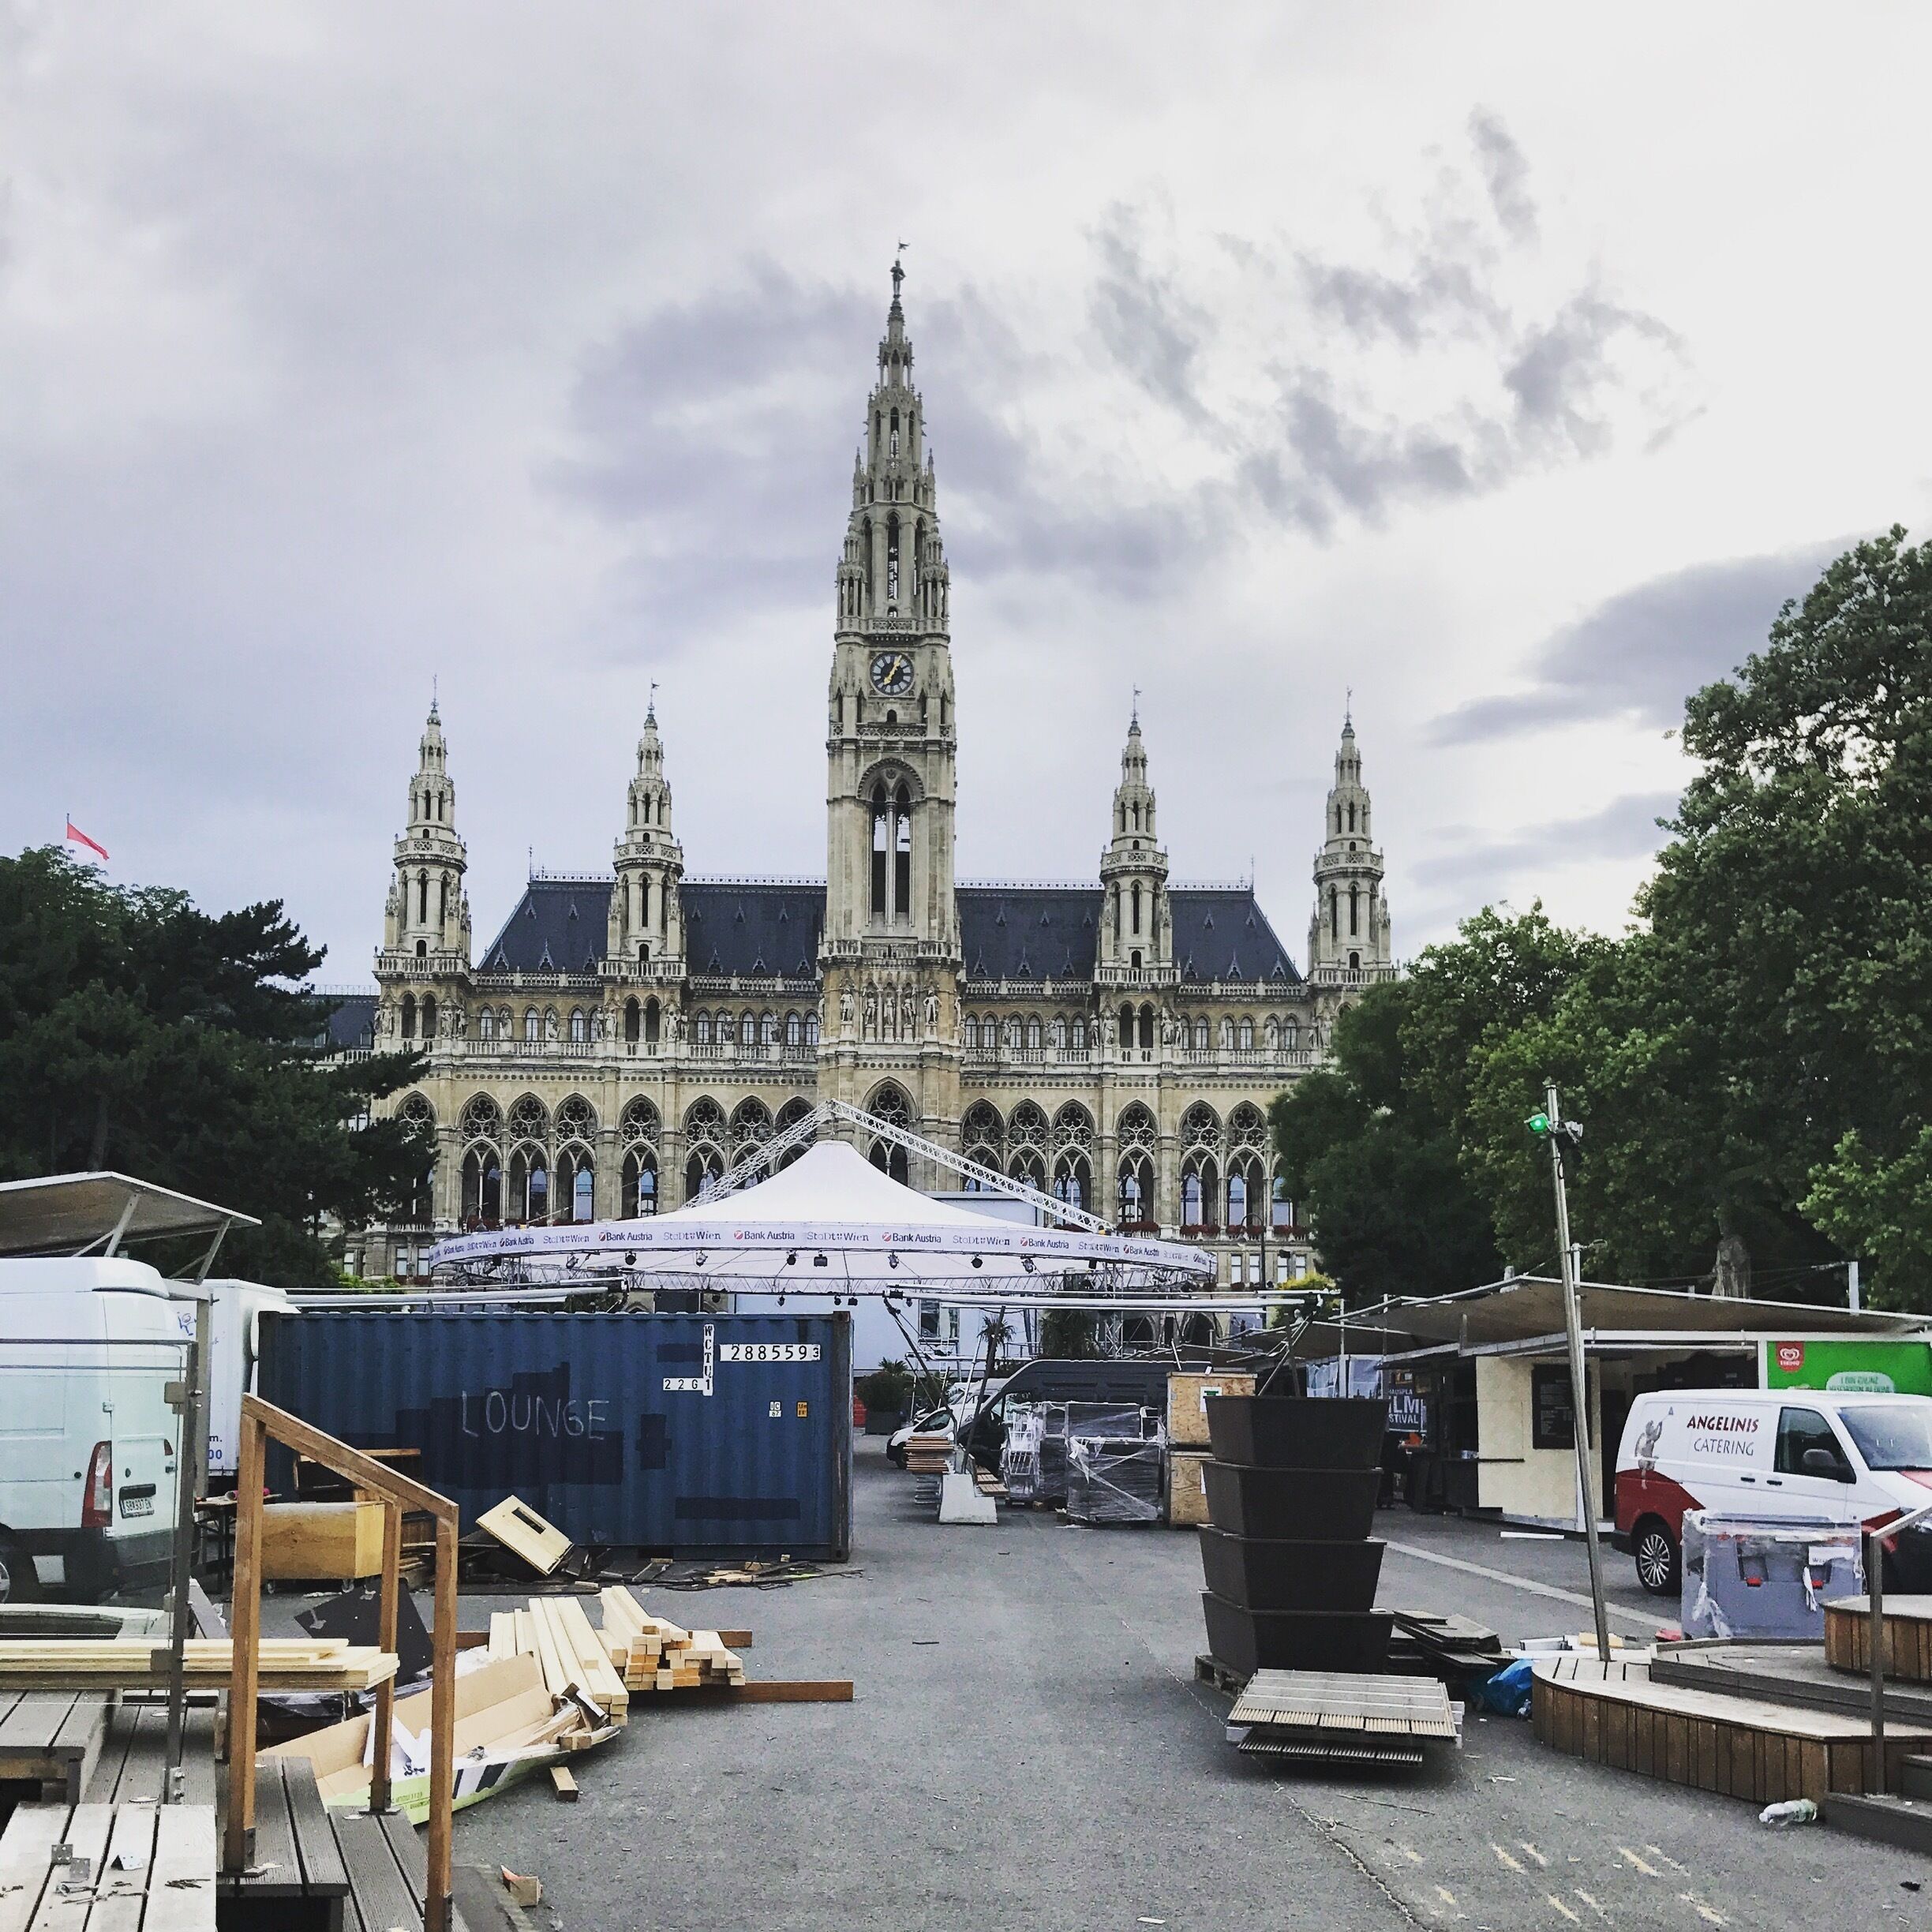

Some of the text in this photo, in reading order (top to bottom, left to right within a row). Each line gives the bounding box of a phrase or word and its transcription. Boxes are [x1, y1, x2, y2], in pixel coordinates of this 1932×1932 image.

[570, 1234, 590, 1243] Wien
[606, 1231, 653, 1241] Bank Austria
[695, 1230, 721, 1240] Wien
[744, 1230, 795, 1240] Bank Austria
[844, 1232, 869, 1241] Wien
[893, 1232, 942, 1243] Bank Austria
[505, 1237, 518, 1246] Bank
[987, 1236, 1010, 1245] Wien
[1028, 1239, 1069, 1249] Bank Austria
[1129, 1245, 1144, 1255] Bank
[462, 1390, 609, 1440] LOUNGE
[1389, 1413, 1419, 1424] STIVAL
[1687, 1415, 1759, 1432] ANGELINIS
[1694, 1438, 1754, 1456] CATERING
[208, 1449, 223, 1459] 00
